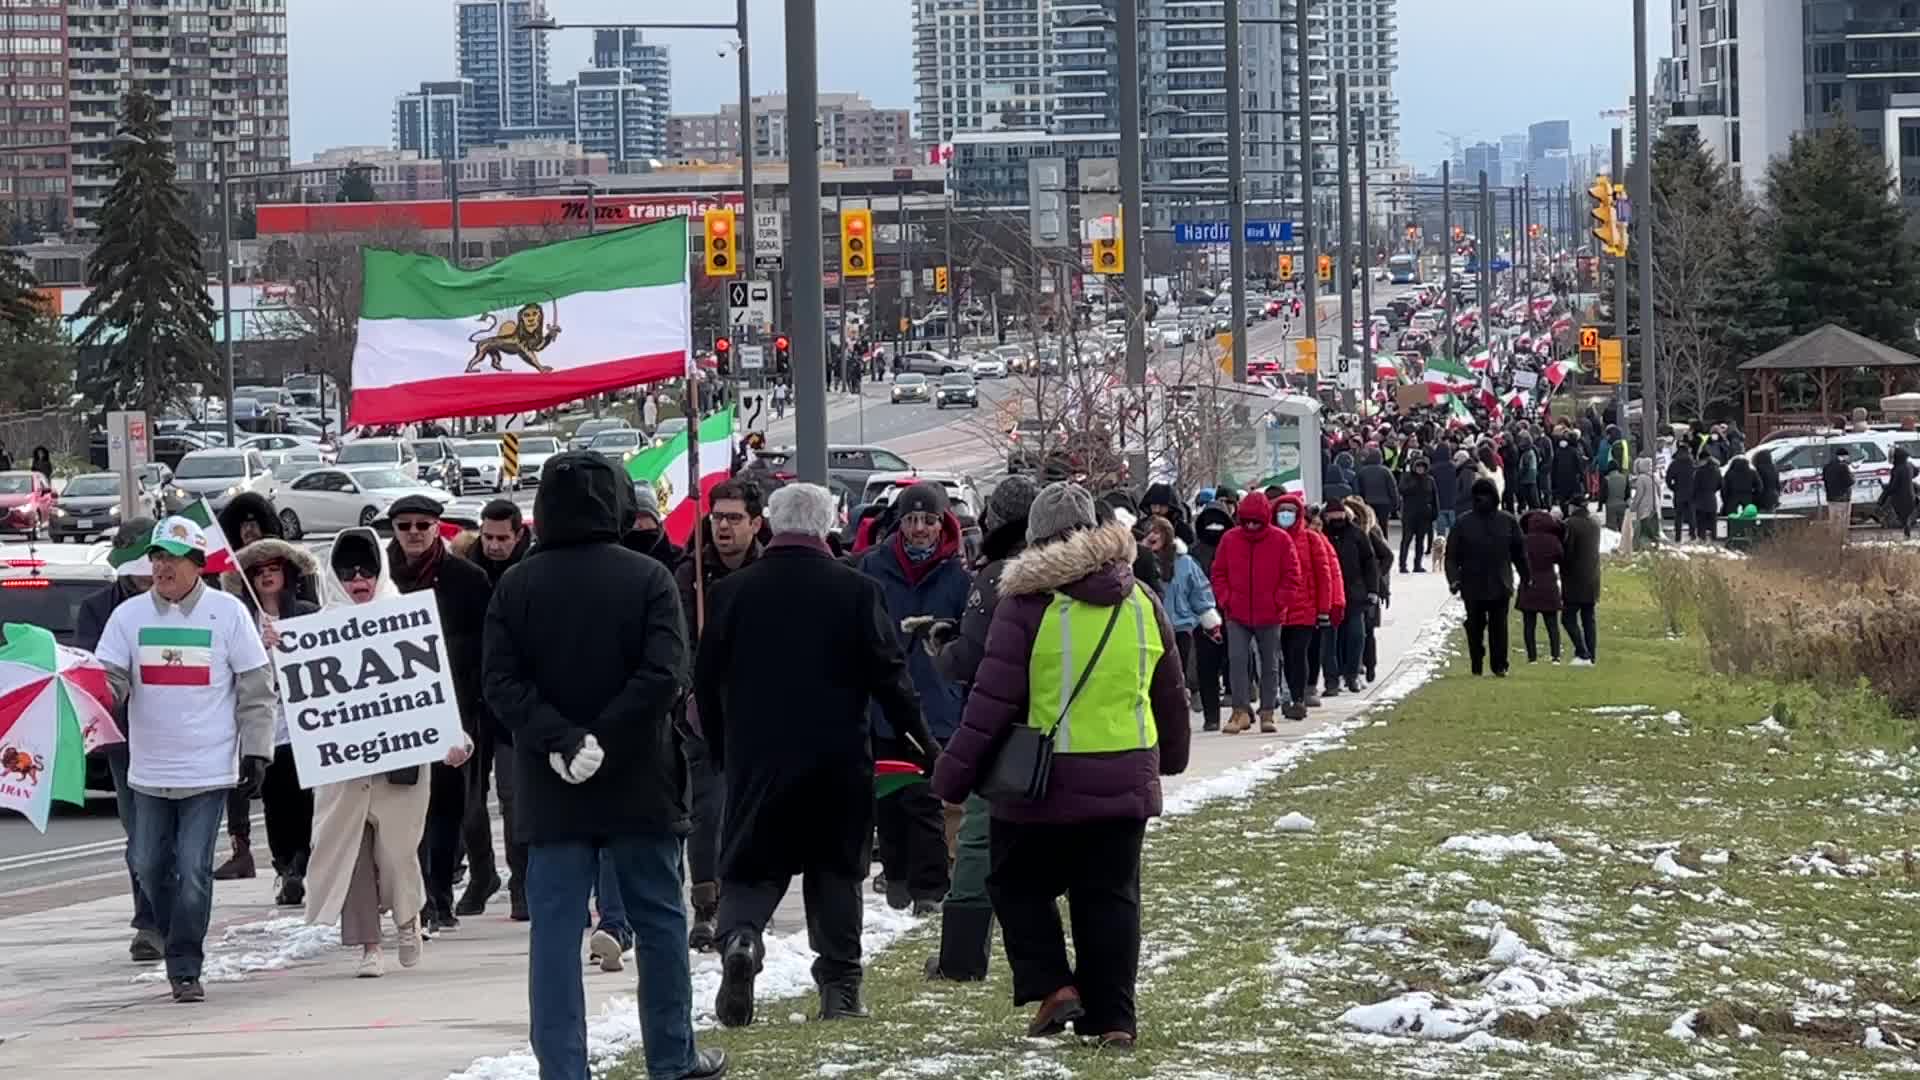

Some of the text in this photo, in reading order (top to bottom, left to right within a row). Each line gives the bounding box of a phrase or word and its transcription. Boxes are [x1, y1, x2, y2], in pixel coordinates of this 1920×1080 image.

[759, 216, 776, 226] LEFT
[1268, 223, 1281, 238] W
[278, 608, 432, 653] Condemn
[281, 634, 441, 703] IRAN
[297, 681, 446, 730] Criminal
[317, 727, 440, 767] Regime
[0, 784, 32, 798] IRAN
